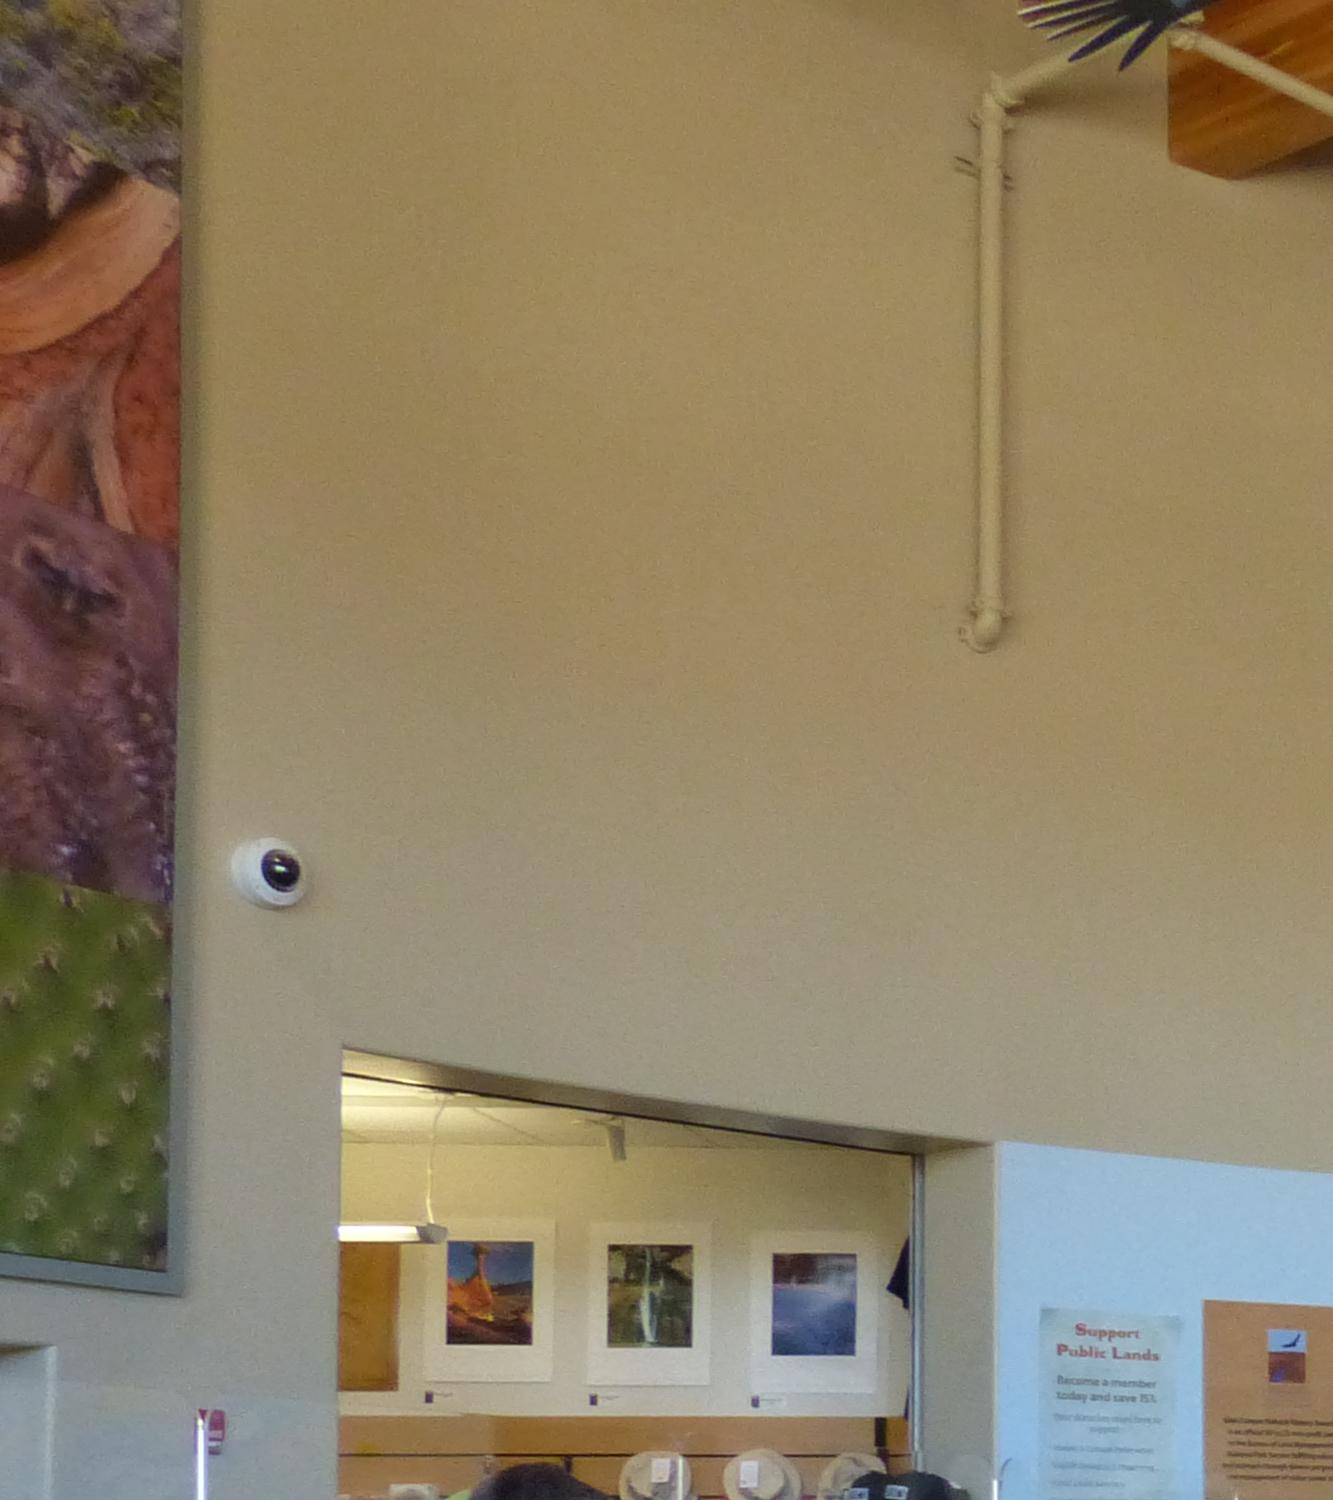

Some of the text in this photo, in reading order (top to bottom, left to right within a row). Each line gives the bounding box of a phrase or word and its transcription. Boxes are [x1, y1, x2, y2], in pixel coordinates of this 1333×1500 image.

[1074, 1322, 1139, 1342] Support
[1056, 1343, 1160, 1361] Public Lands
[1057, 1374, 1100, 1387] Become
[1111, 1378, 1157, 1389] member
[1056, 1391, 1088, 1404] today
[1090, 1392, 1111, 1402] and
[1113, 1394, 1137, 1404] save
